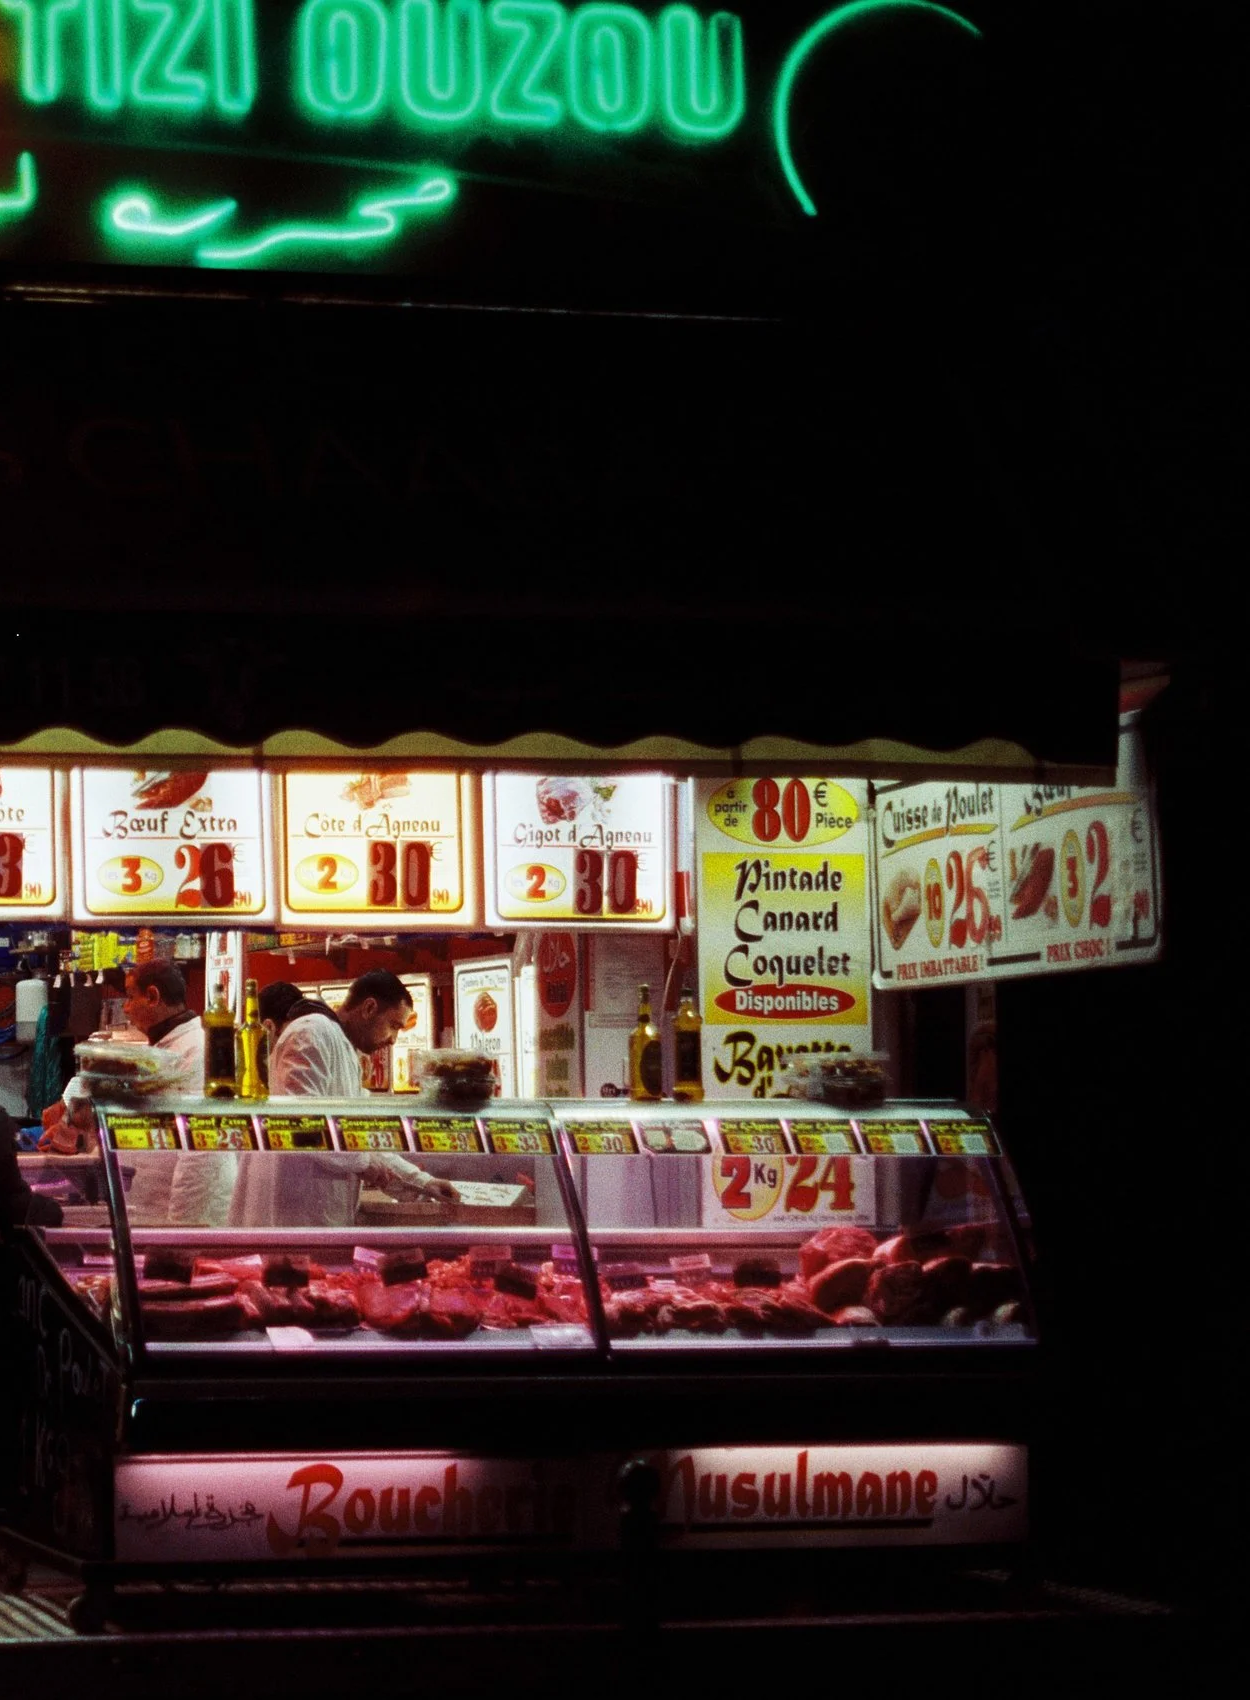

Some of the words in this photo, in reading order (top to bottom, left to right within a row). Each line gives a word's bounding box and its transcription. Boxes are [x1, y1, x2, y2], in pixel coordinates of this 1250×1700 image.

[295, 0, 747, 140] OUZOU
[101, 810, 169, 840] Bœuf
[178, 810, 239, 841] Extra
[303, 812, 346, 840] Côte
[713, 800, 748, 816] partir
[723, 813, 739, 828] de
[751, 778, 812, 843] 80
[815, 812, 853, 830] Pièce
[881, 800, 928, 849] Cuisse
[945, 781, 995, 835] Poulet
[513, 822, 563, 849] Gigot
[120, 855, 143, 894] 3
[174, 842, 235, 909] 26
[316, 856, 339, 890] 2
[367, 840, 431, 909] 30
[432, 890, 450, 905] 90
[526, 865, 547, 899] 2
[575, 848, 638, 916] 30
[734, 858, 843, 902] Pintade
[735, 900, 839, 942] Canard
[926, 882, 942, 920] 10
[723, 944, 851, 988] Coquelet
[734, 990, 840, 1015] Disponibles
[720, 1156, 751, 1209] 2
[753, 1162, 778, 1189] Kg
[784, 1156, 857, 1213] 24
